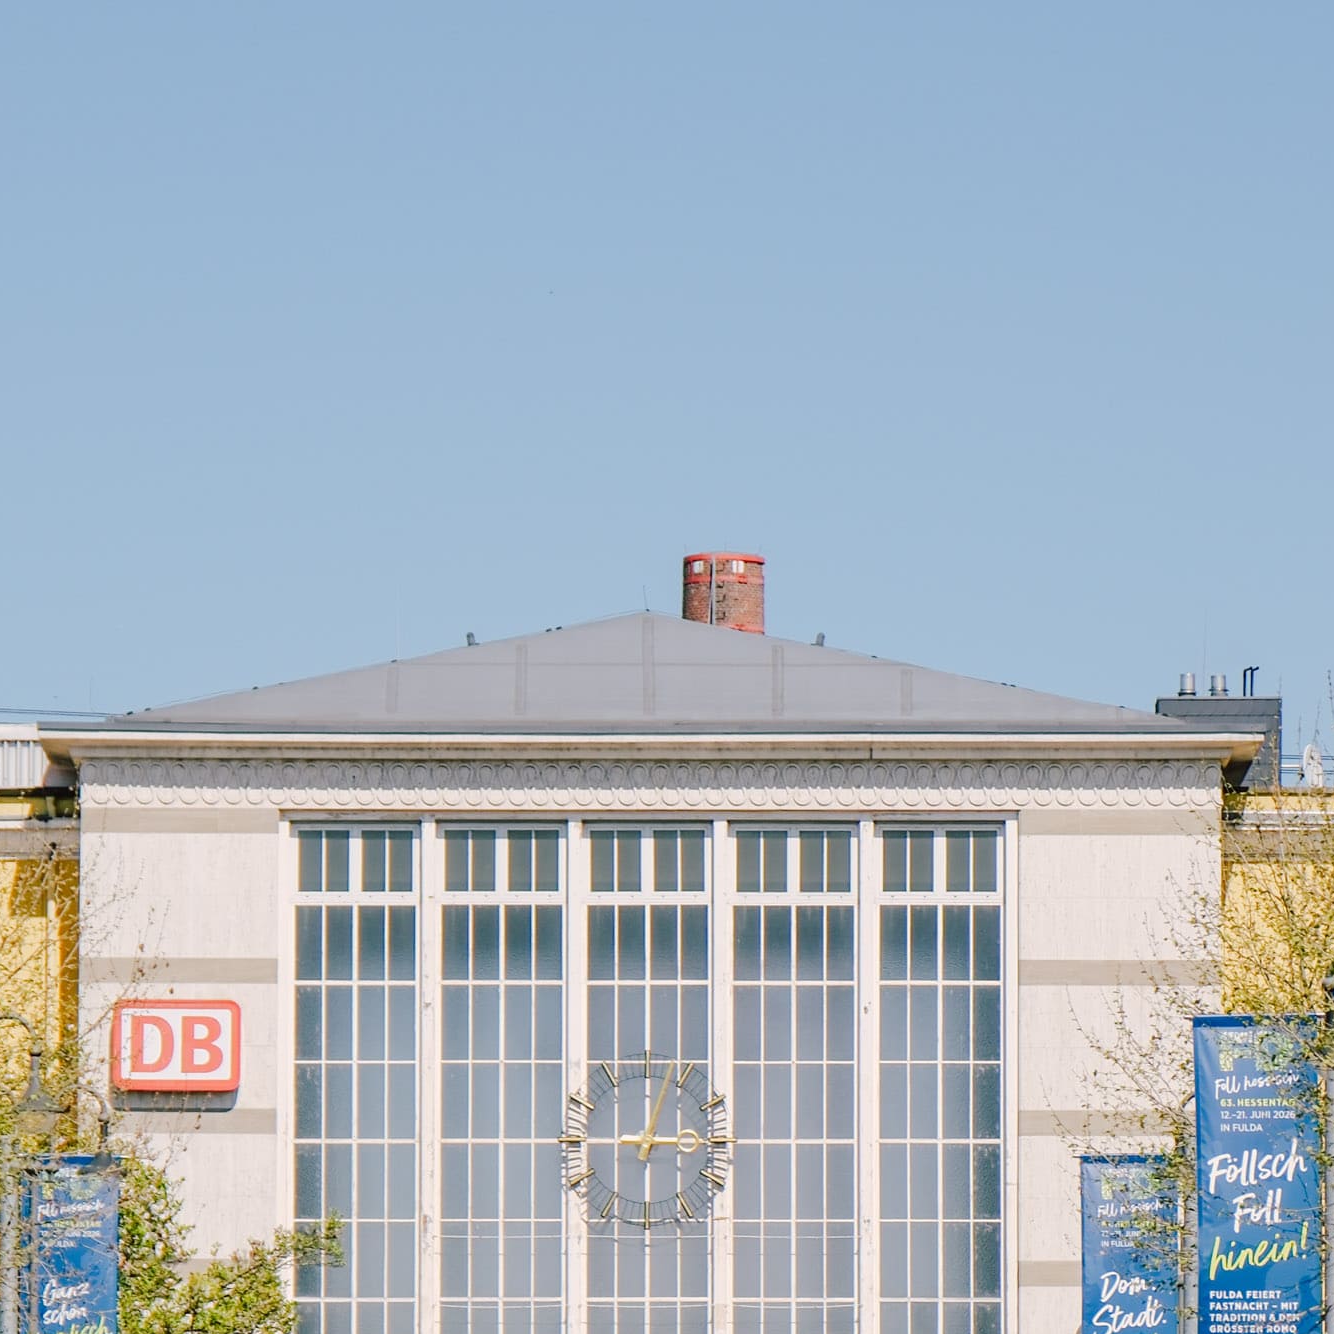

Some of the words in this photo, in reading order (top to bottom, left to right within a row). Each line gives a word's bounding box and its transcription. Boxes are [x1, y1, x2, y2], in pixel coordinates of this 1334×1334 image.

[130, 1016, 223, 1073] DB
[1215, 1076, 1240, 1100] Foll
[1220, 1099, 1235, 1107] 63.
[1237, 1099, 1295, 1107] HESSENTAG
[1249, 1111, 1270, 1119] JUNI
[1273, 1111, 1295, 1119] 2026
[1220, 1124, 1229, 1132] IN
[1233, 1124, 1263, 1132] FULDA
[1207, 1138, 1307, 1194] Föllsch
[1233, 1188, 1282, 1233] Foll
[1210, 1221, 1308, 1280] hinein!
[43, 1279, 90, 1306] Ganz
[1101, 1271, 1156, 1303] Dom.
[1209, 1290, 1243, 1299] FULDA
[1246, 1290, 1281, 1299] FEIERT
[1209, 1302, 1269, 1310] FASTNACHT
[1280, 1302, 1299, 1310] MIT
[1209, 1324, 1264, 1333] GRÖSSTEN
